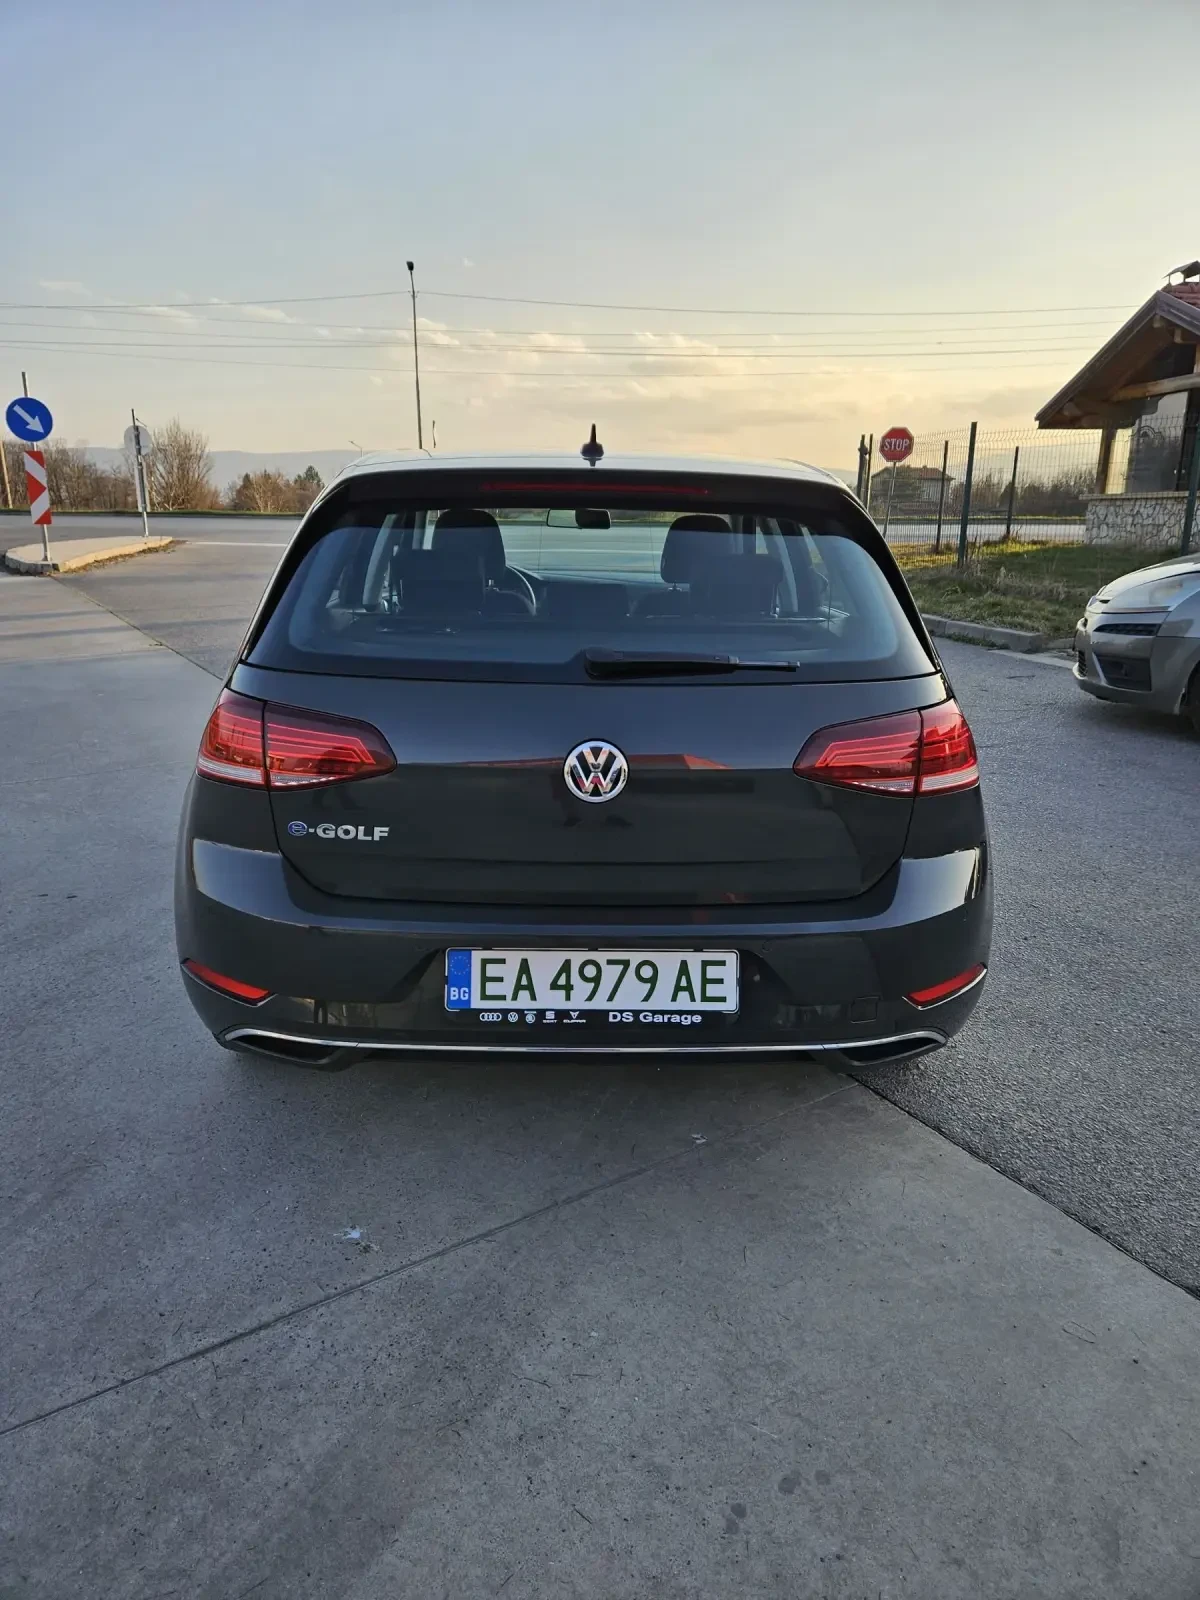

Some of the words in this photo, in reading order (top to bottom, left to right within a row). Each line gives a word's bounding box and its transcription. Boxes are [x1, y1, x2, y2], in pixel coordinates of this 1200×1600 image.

[884, 438, 910, 451] STOP
[480, 958, 537, 1001] EA
[549, 958, 659, 1002] 4979
[671, 959, 727, 1002] AE
[450, 987, 469, 1000] BG
[608, 1011, 634, 1022] DS
[639, 1012, 702, 1025] Garage
